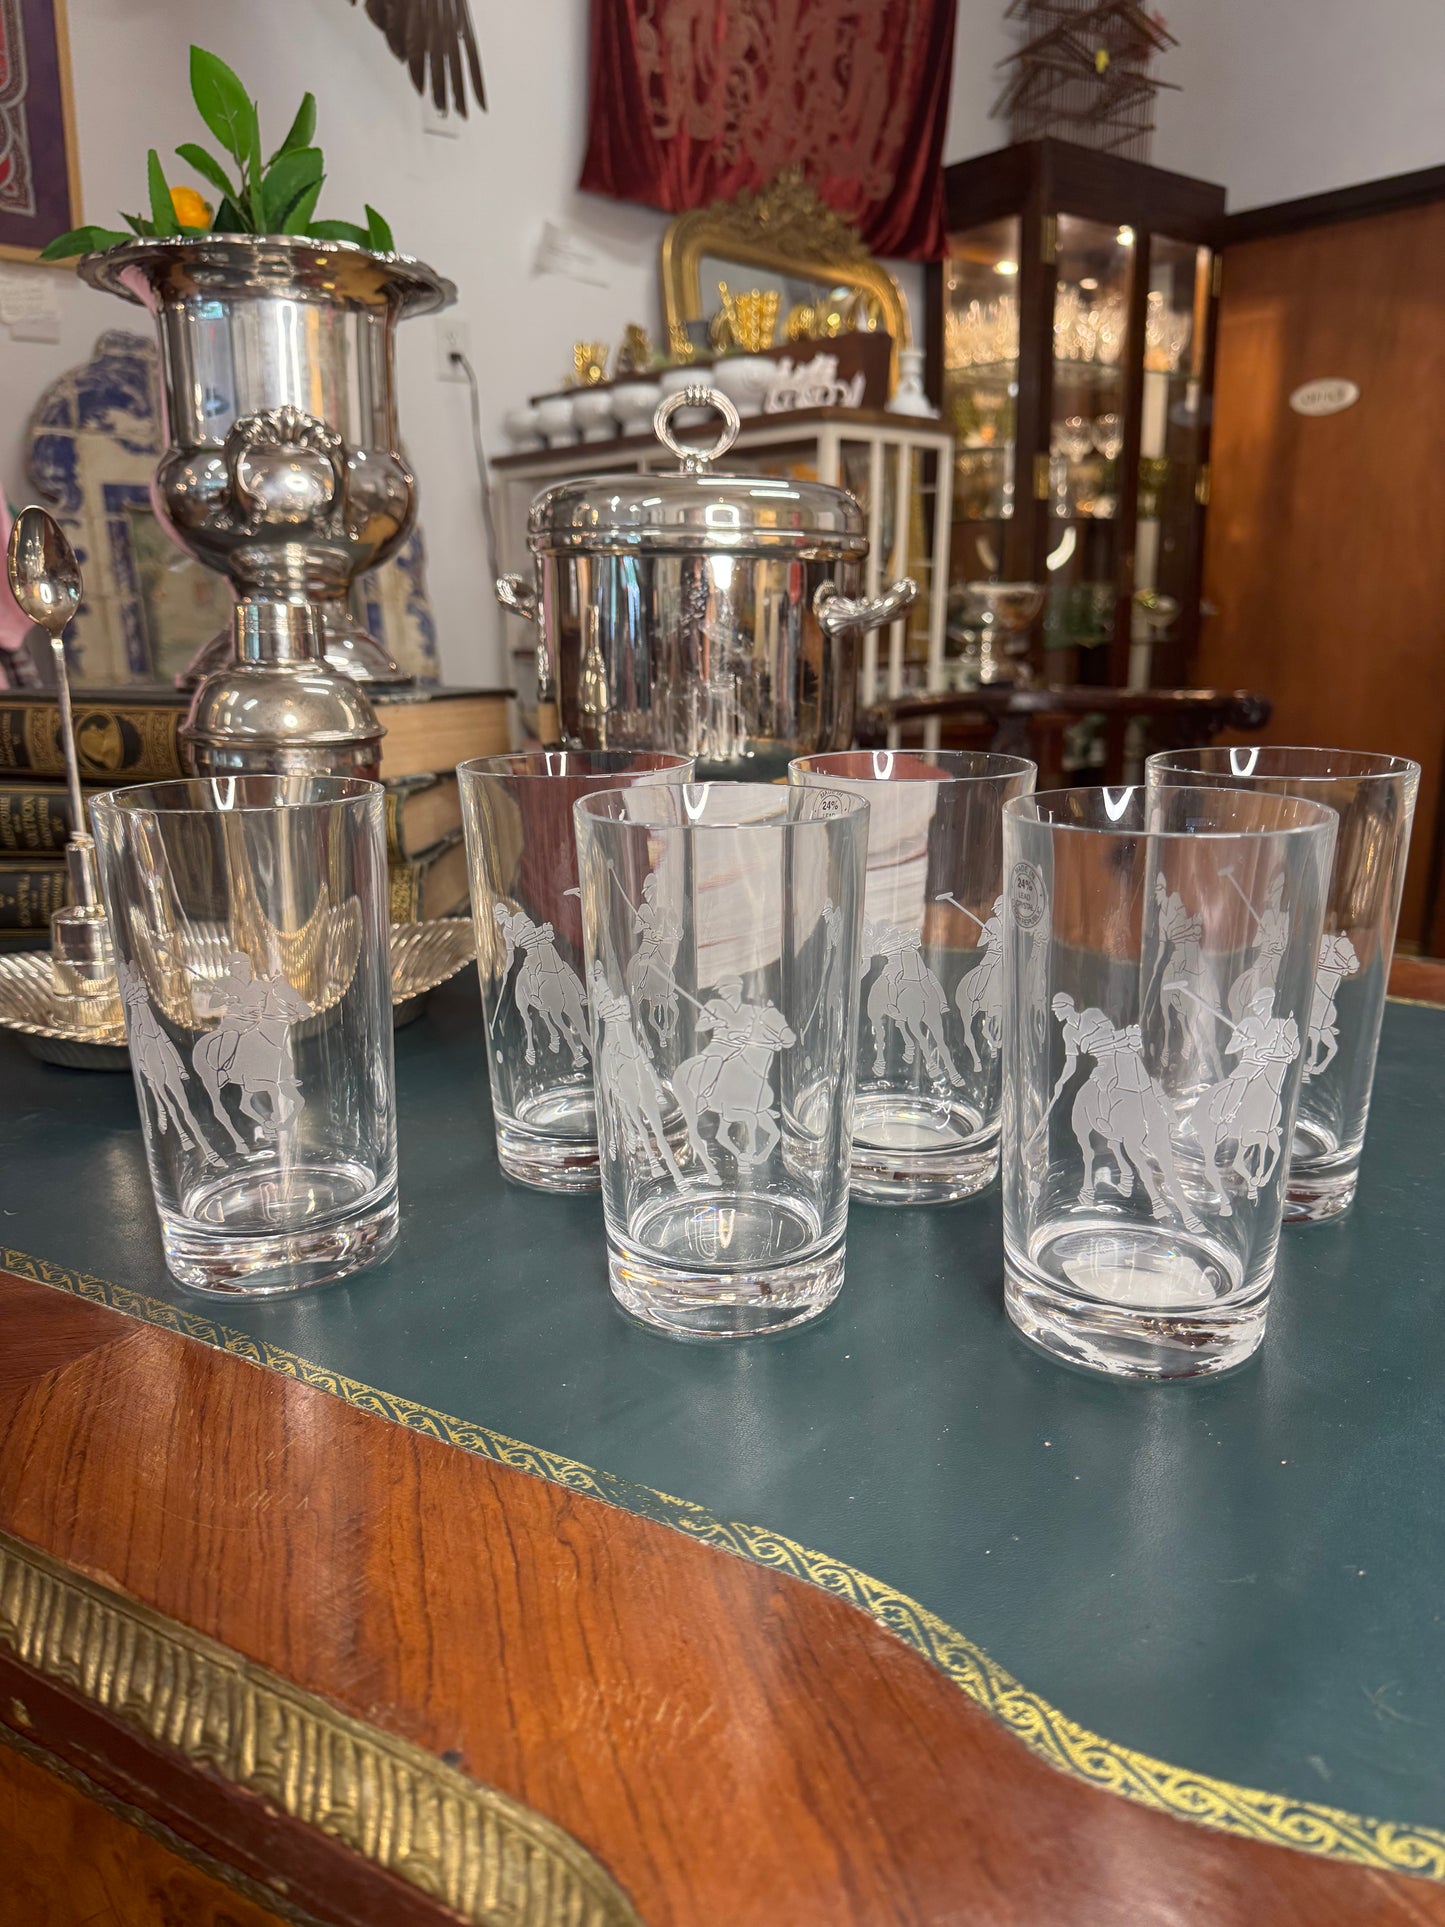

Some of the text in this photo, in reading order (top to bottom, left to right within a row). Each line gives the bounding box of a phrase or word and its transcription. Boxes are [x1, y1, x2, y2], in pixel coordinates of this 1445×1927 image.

[822, 800, 838, 810] 24%
[1017, 878, 1033, 891] 24%
[1019, 892, 1031, 901] LEAD
